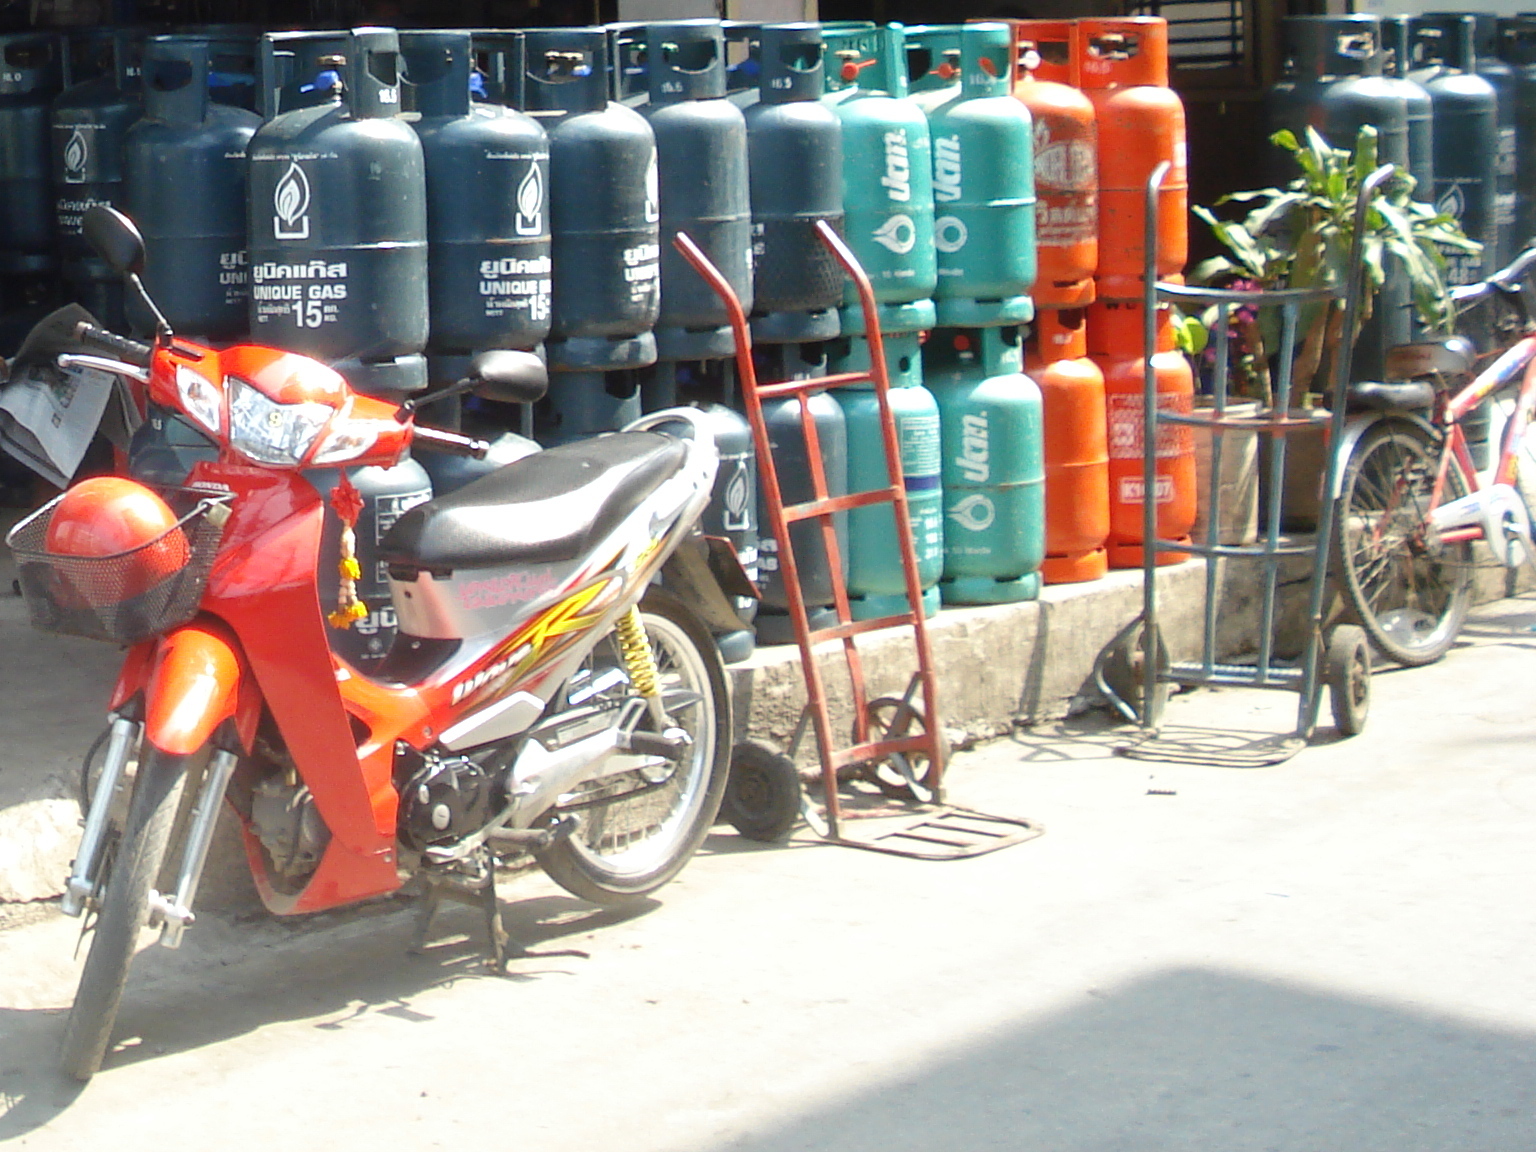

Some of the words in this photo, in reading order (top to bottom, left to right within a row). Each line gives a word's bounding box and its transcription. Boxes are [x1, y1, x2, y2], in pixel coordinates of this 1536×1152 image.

[253, 285, 302, 300] UNIQUE
[309, 284, 347, 299] GAS
[479, 280, 537, 295] UNIQUE
[292, 300, 322, 328] 15
